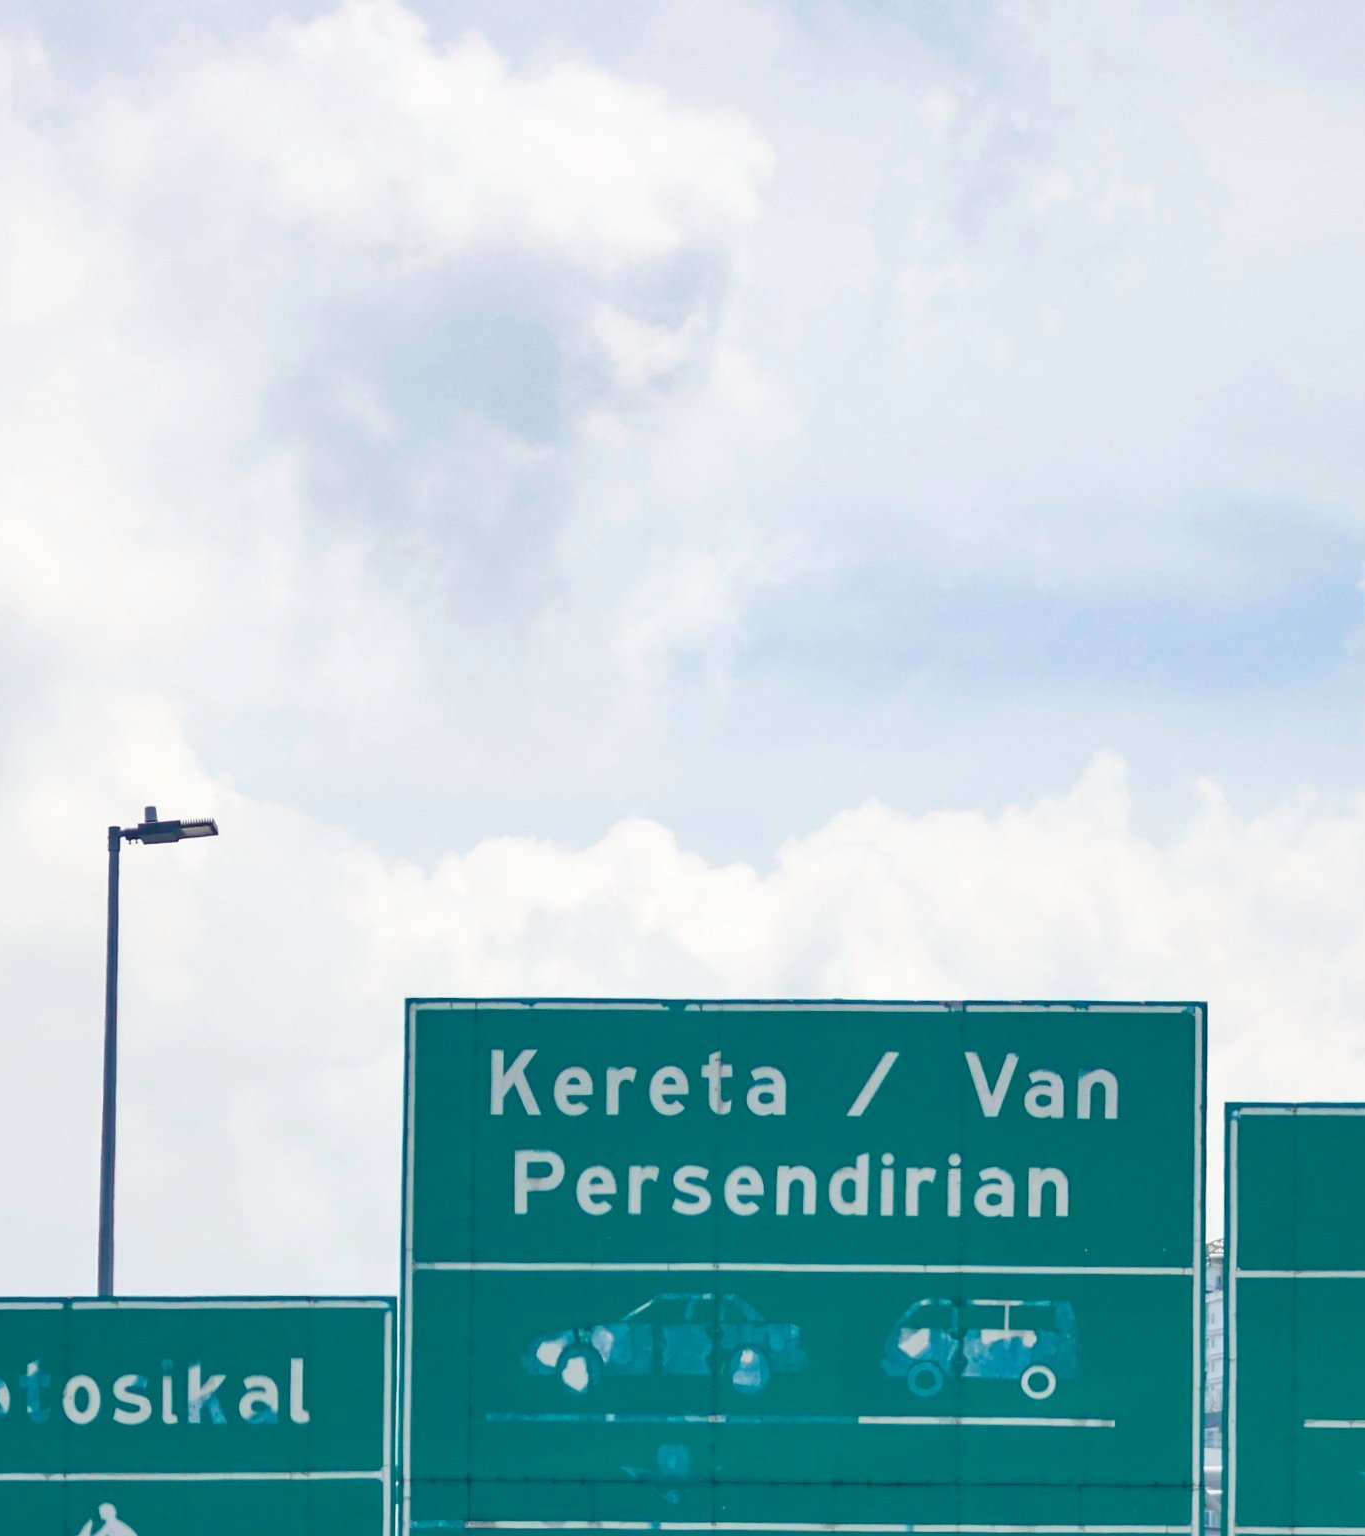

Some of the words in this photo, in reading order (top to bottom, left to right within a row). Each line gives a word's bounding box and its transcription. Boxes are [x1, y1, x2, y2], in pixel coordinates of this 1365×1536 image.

[491, 1049, 787, 1116] Kereta
[847, 1051, 899, 1116] /
[965, 1051, 1119, 1119] Van
[514, 1149, 1069, 1218] Persendirian
